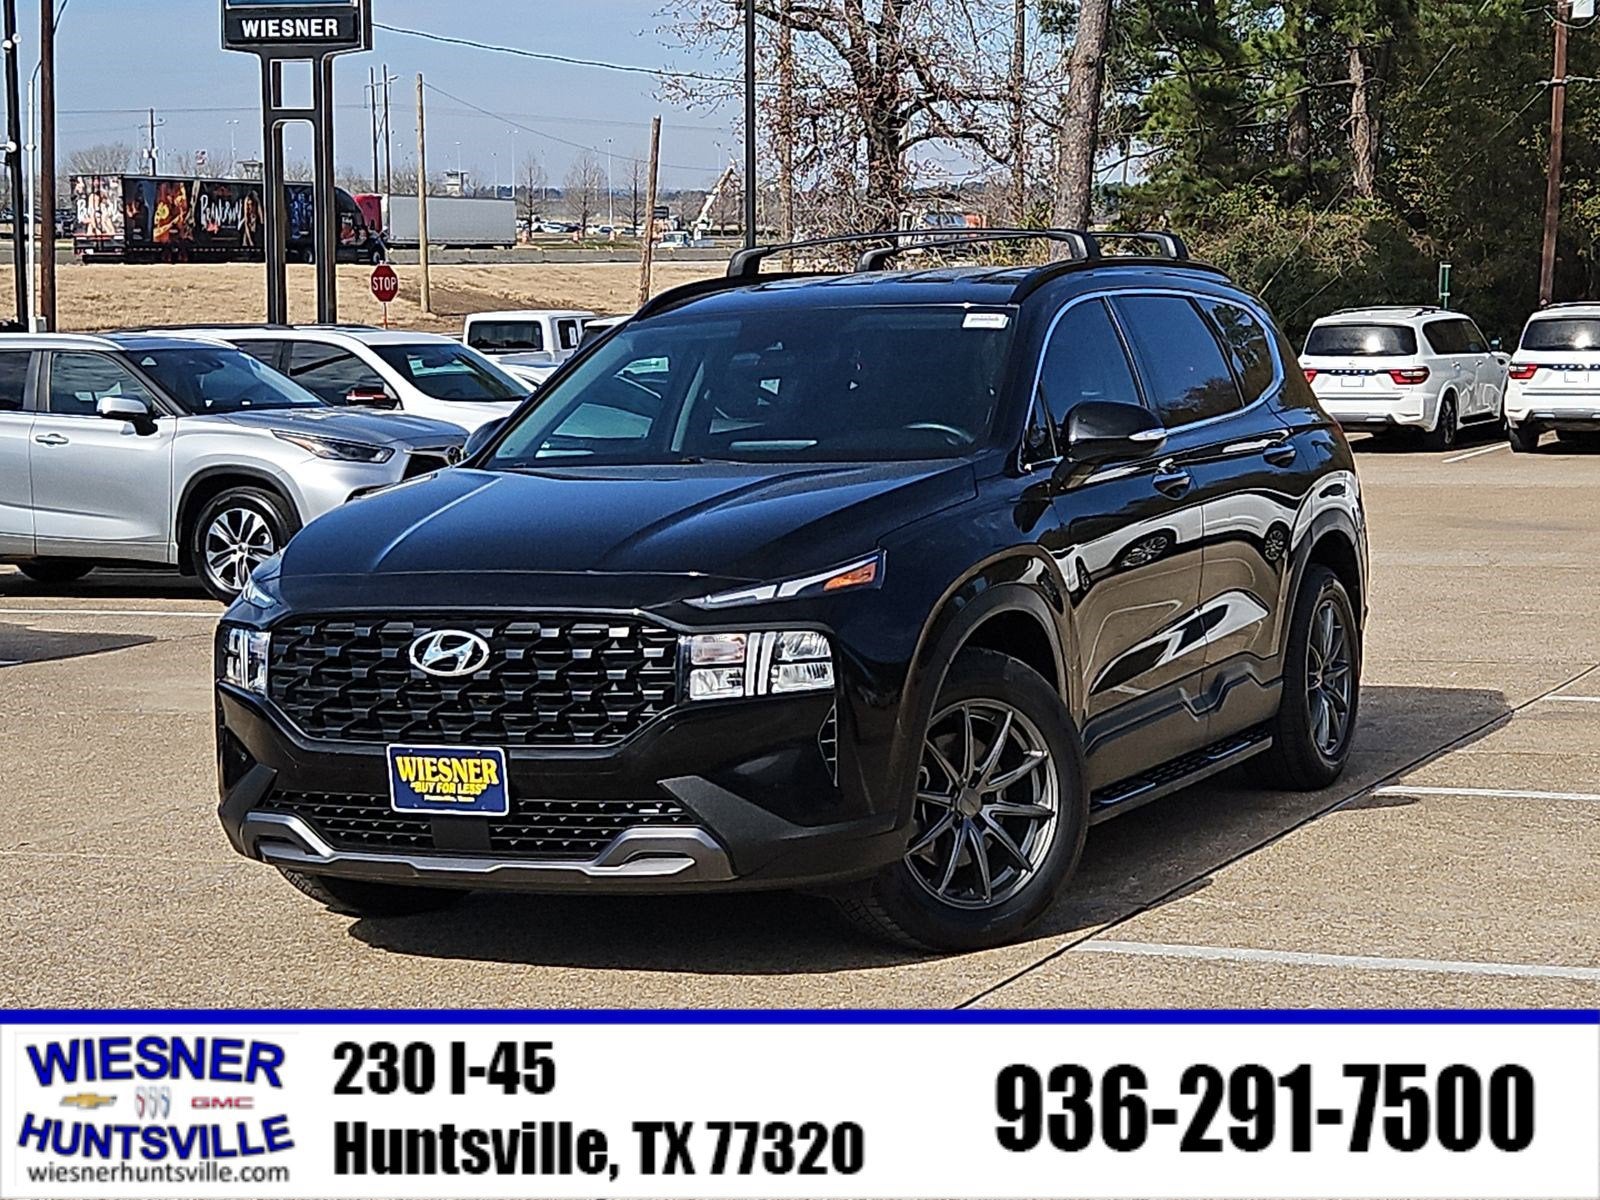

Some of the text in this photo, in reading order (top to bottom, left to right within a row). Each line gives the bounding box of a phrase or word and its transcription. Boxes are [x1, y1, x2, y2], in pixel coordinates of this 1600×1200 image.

[241, 18, 338, 38] WIESNER
[372, 276, 397, 291] STOP
[395, 756, 499, 785] WIESNER
[436, 781, 456, 794] FOR
